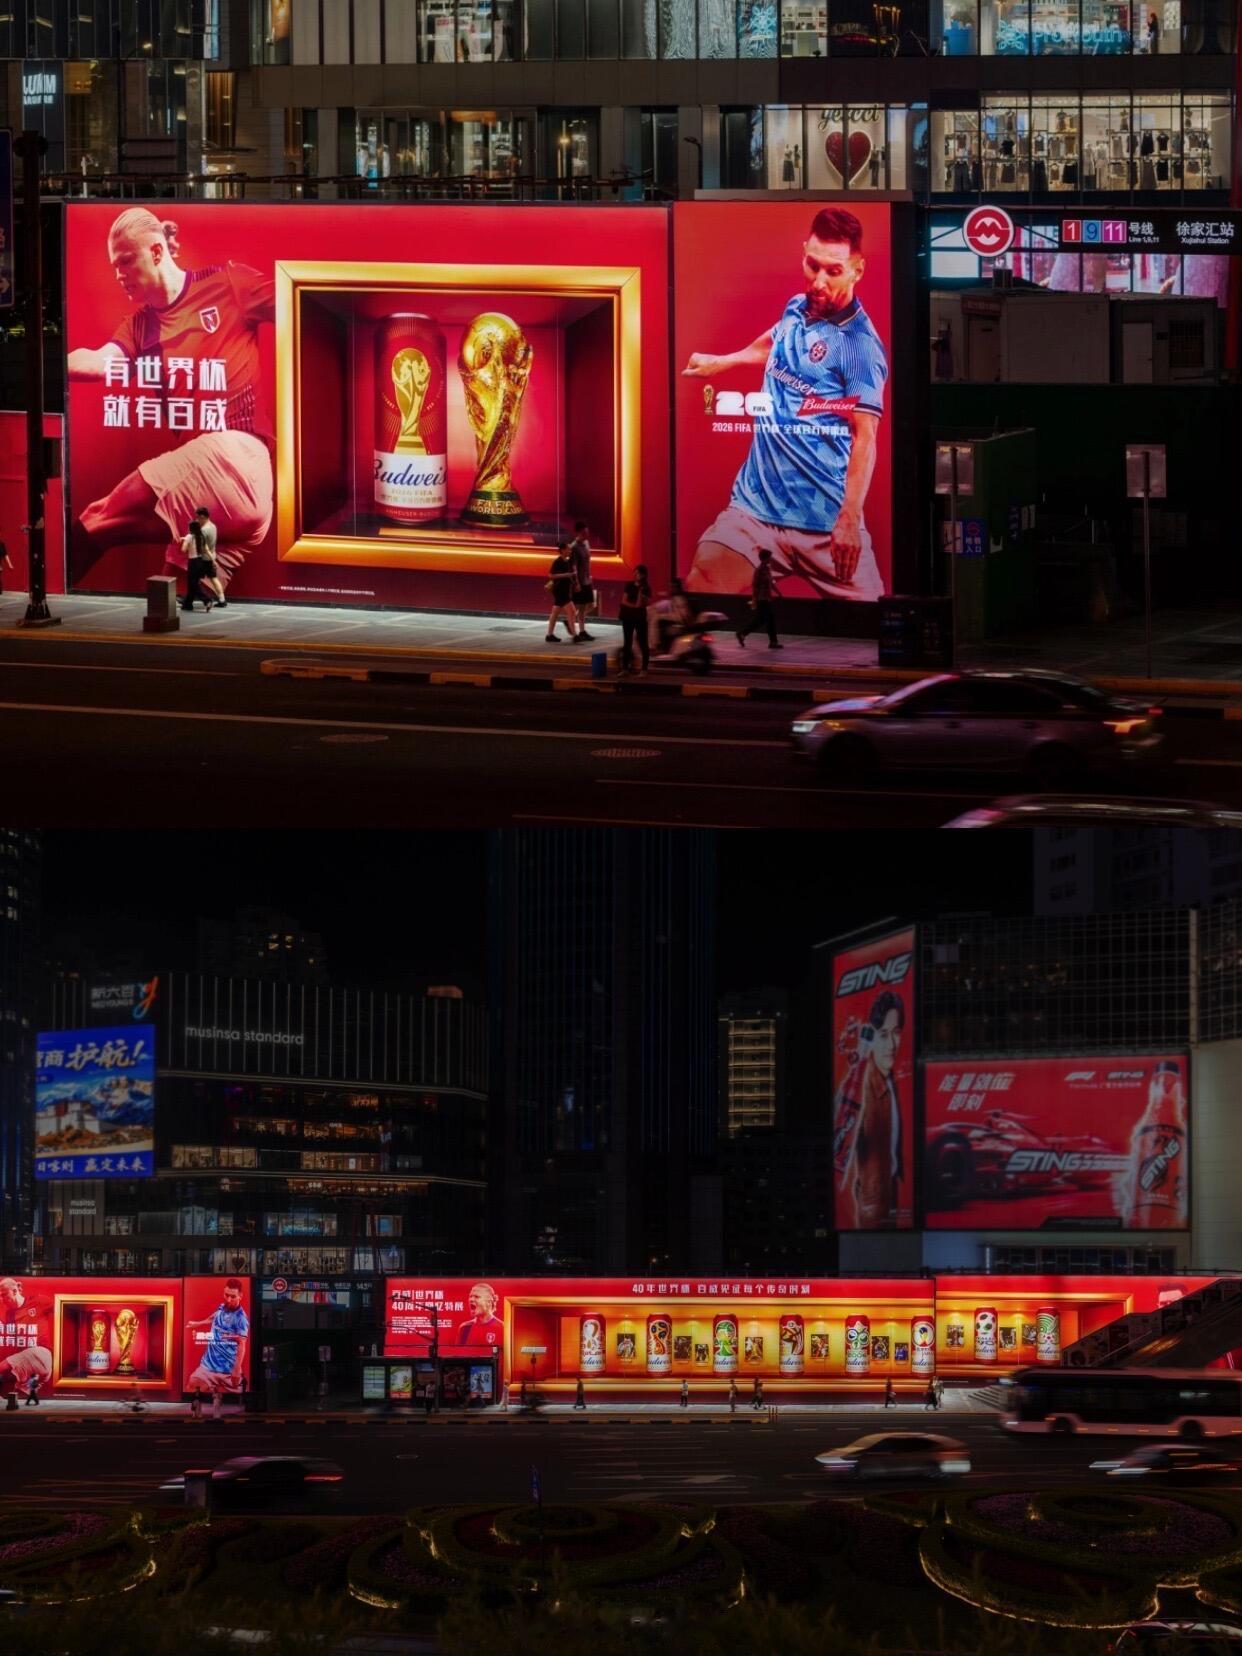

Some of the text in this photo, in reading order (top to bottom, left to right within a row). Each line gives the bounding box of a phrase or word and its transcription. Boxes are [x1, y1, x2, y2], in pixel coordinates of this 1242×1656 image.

[1067, 222, 1154, 241] 1 9 11 号线
[1176, 221, 1235, 237] 徐家汇站
[103, 355, 227, 391] 有世界杯
[103, 394, 227, 432] 就有百威
[752, 405, 767, 413] FIFA
[712, 422, 733, 432] 2026
[734, 423, 751, 433] FIFA
[838, 952, 912, 997] STING
[185, 1025, 305, 1045] musinsa standard
[1006, 1150, 1080, 1172] STING
